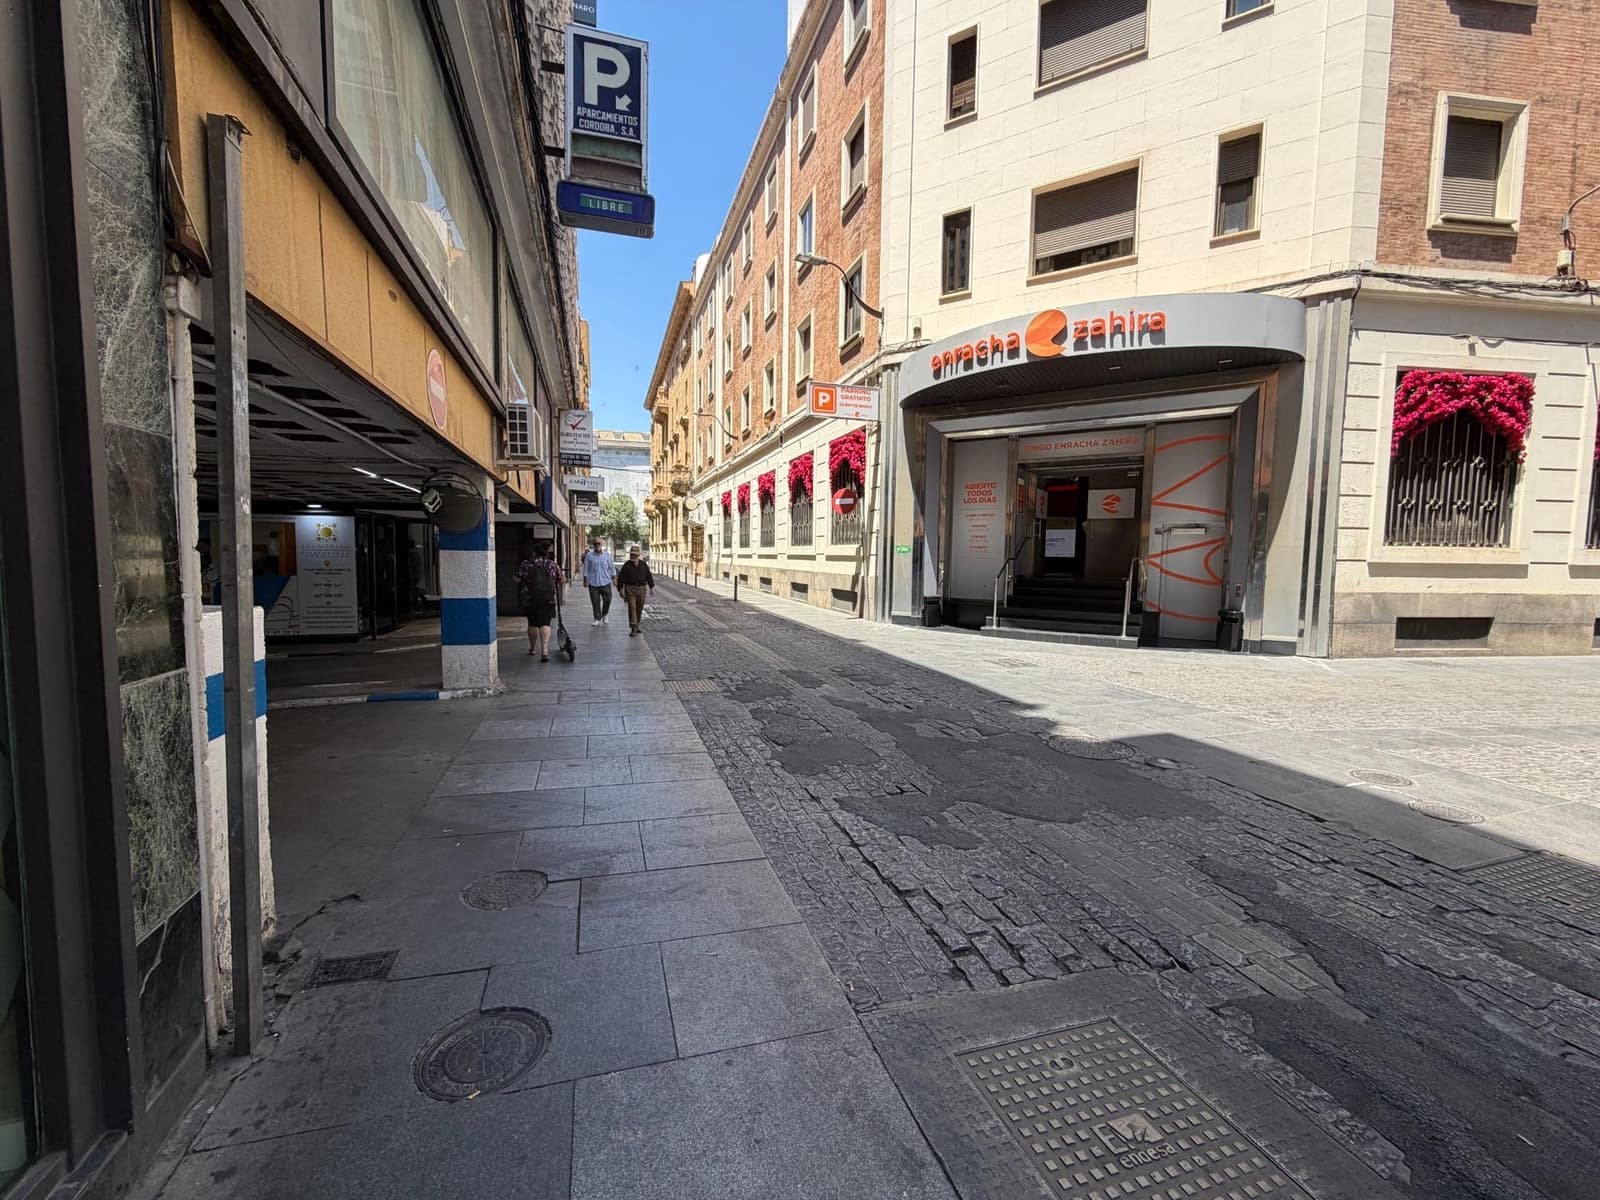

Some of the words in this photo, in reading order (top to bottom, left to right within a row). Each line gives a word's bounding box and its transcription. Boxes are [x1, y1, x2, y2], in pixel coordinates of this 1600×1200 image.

[583, 41, 631, 106] P
[576, 106, 638, 126] APARCAMIENTOS
[621, 125, 637, 138] S.A.
[589, 199, 625, 213] LIBRE
[930, 330, 1020, 370] enracha
[1072, 308, 1166, 340] zahira
[840, 386, 872, 396] PARKING
[818, 391, 831, 408] P
[1023, 443, 1052, 452] BINGO
[1055, 440, 1099, 450] ENRACHA
[1102, 436, 1138, 447] ZAHIRA
[964, 482, 997, 490] ABIERTO
